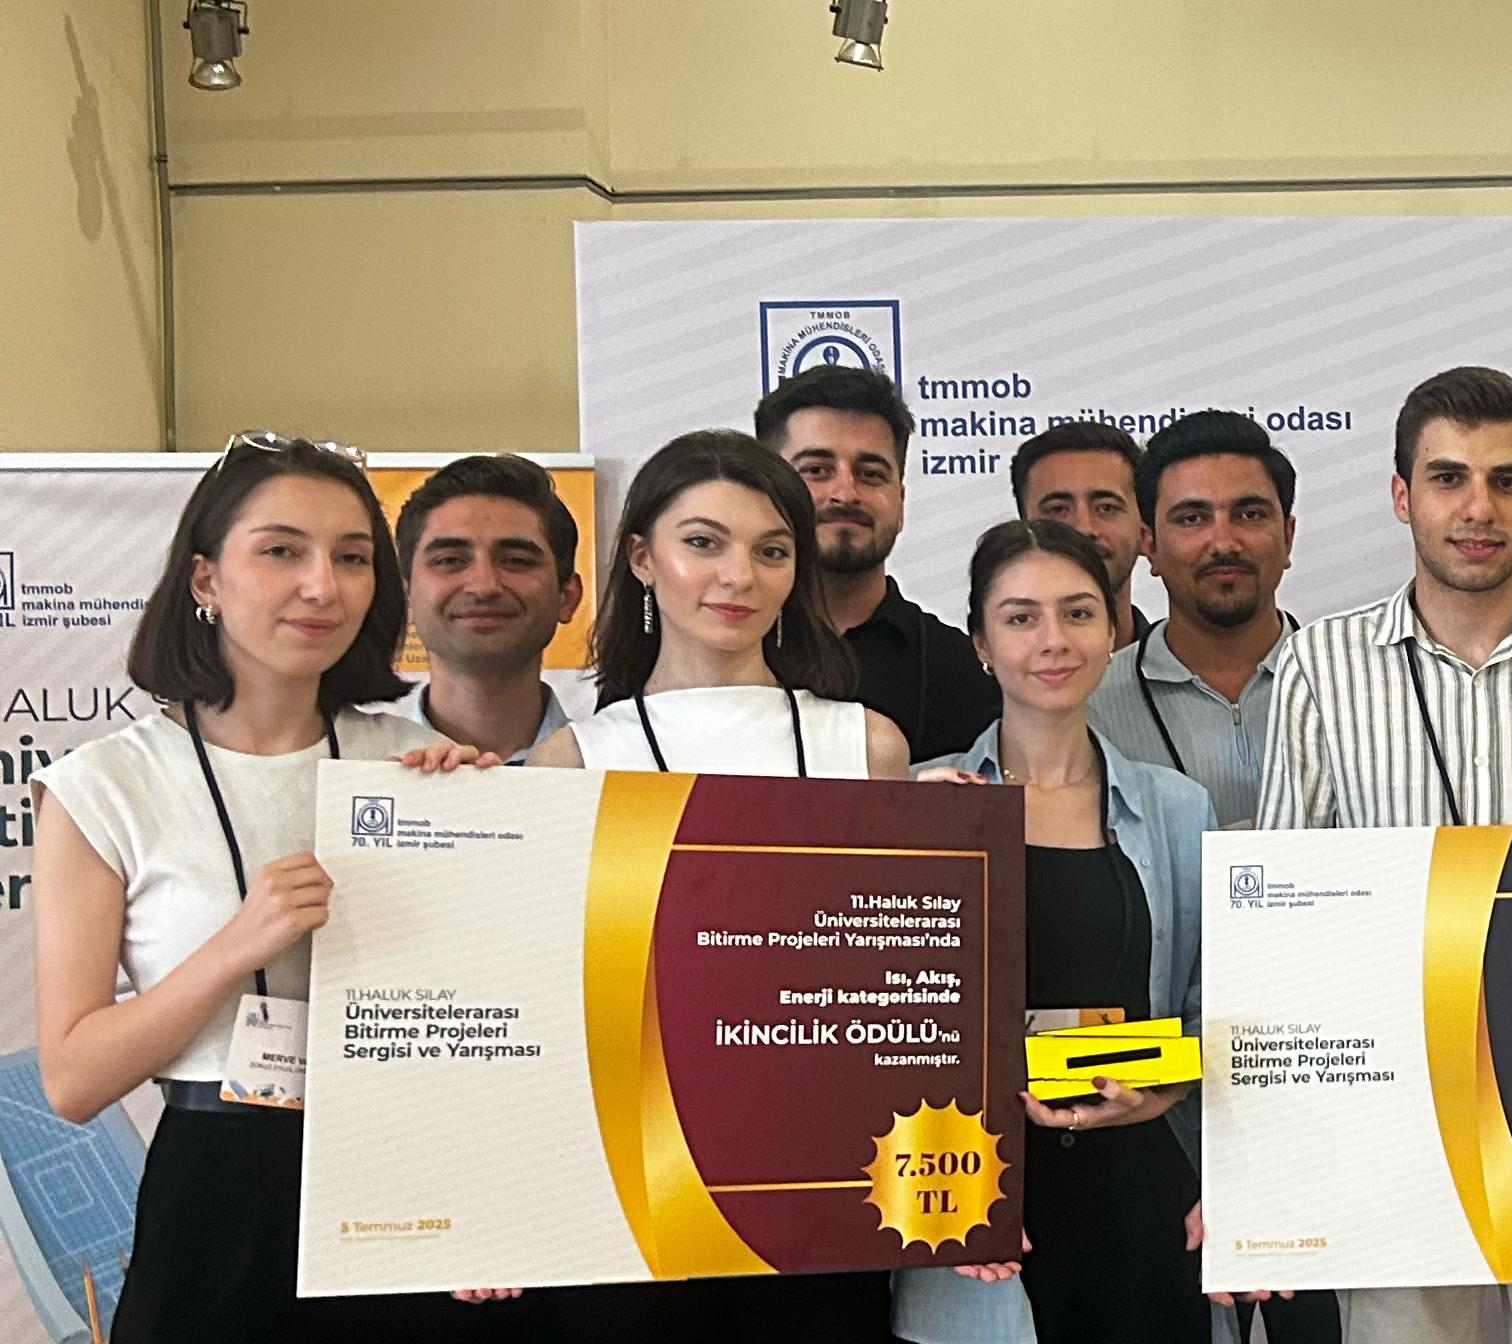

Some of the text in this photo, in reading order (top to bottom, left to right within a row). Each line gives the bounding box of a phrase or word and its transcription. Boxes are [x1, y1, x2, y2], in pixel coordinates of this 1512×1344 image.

[810, 311, 851, 319] TMMOB
[918, 373, 1032, 400] tmmob
[920, 410, 1036, 438] makina
[1266, 406, 1352, 432] odası
[921, 450, 1000, 475] izmir
[21, 583, 73, 595] tmmob
[21, 598, 147, 611] makina mühendi
[22, 615, 58, 627] izmir
[63, 614, 111, 629] şubesi
[851, 895, 961, 913] 11.Haluk Sılay
[814, 909, 961, 929] Üniversitelerarası
[697, 931, 960, 950] Bitirme Projeleri Yarışması'nda
[886, 970, 961, 988] Isı, Akış,
[415, 989, 456, 1001] SILAY
[779, 987, 961, 1007] Enerji kategorisinde
[345, 1002, 519, 1020] Üniversitelerarası
[345, 1022, 508, 1042] Bitirme Projeleri
[715, 1018, 839, 1046] İKİNCİLİK
[1288, 1023, 1322, 1035] SILAY
[343, 1042, 541, 1062] Sergisi ve Yarışması
[1231, 1036, 1375, 1052] Üniversitelerarası
[874, 1053, 960, 1068] kazanmıştır.
[1231, 1051, 1366, 1069] Bitirme Projeleri
[1231, 1069, 1395, 1088] Sergisi ve Yarışması
[895, 1151, 981, 1177] 7.500
[916, 1189, 958, 1214] TL
[418, 1219, 451, 1230] 2025
[1298, 1238, 1327, 1248] 2025
